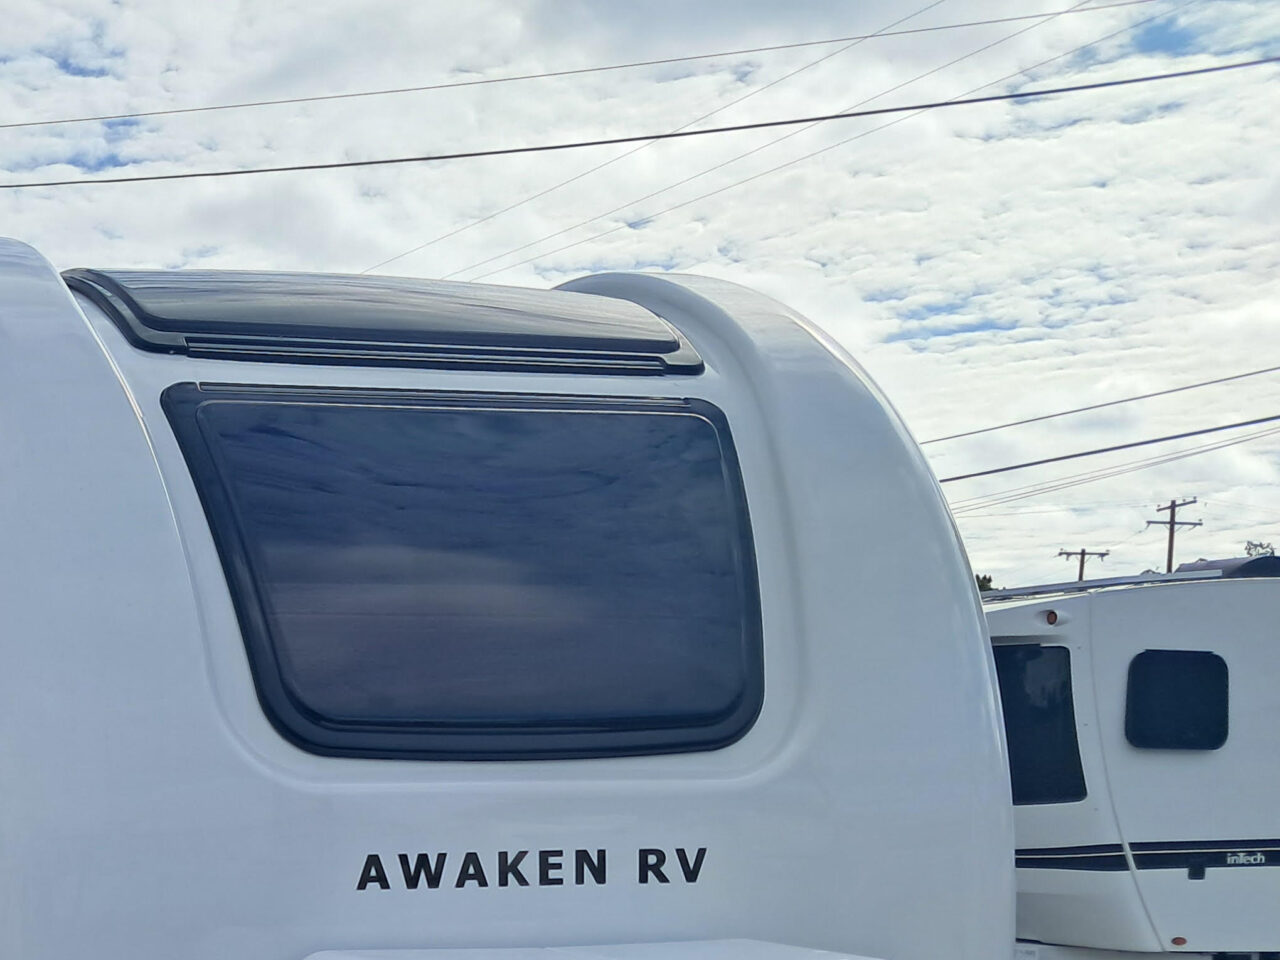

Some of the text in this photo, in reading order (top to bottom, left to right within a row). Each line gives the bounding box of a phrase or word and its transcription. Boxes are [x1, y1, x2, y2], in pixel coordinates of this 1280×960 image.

[356, 848, 708, 891] AWAKEN RV
[1227, 852, 1265, 864] inTech
